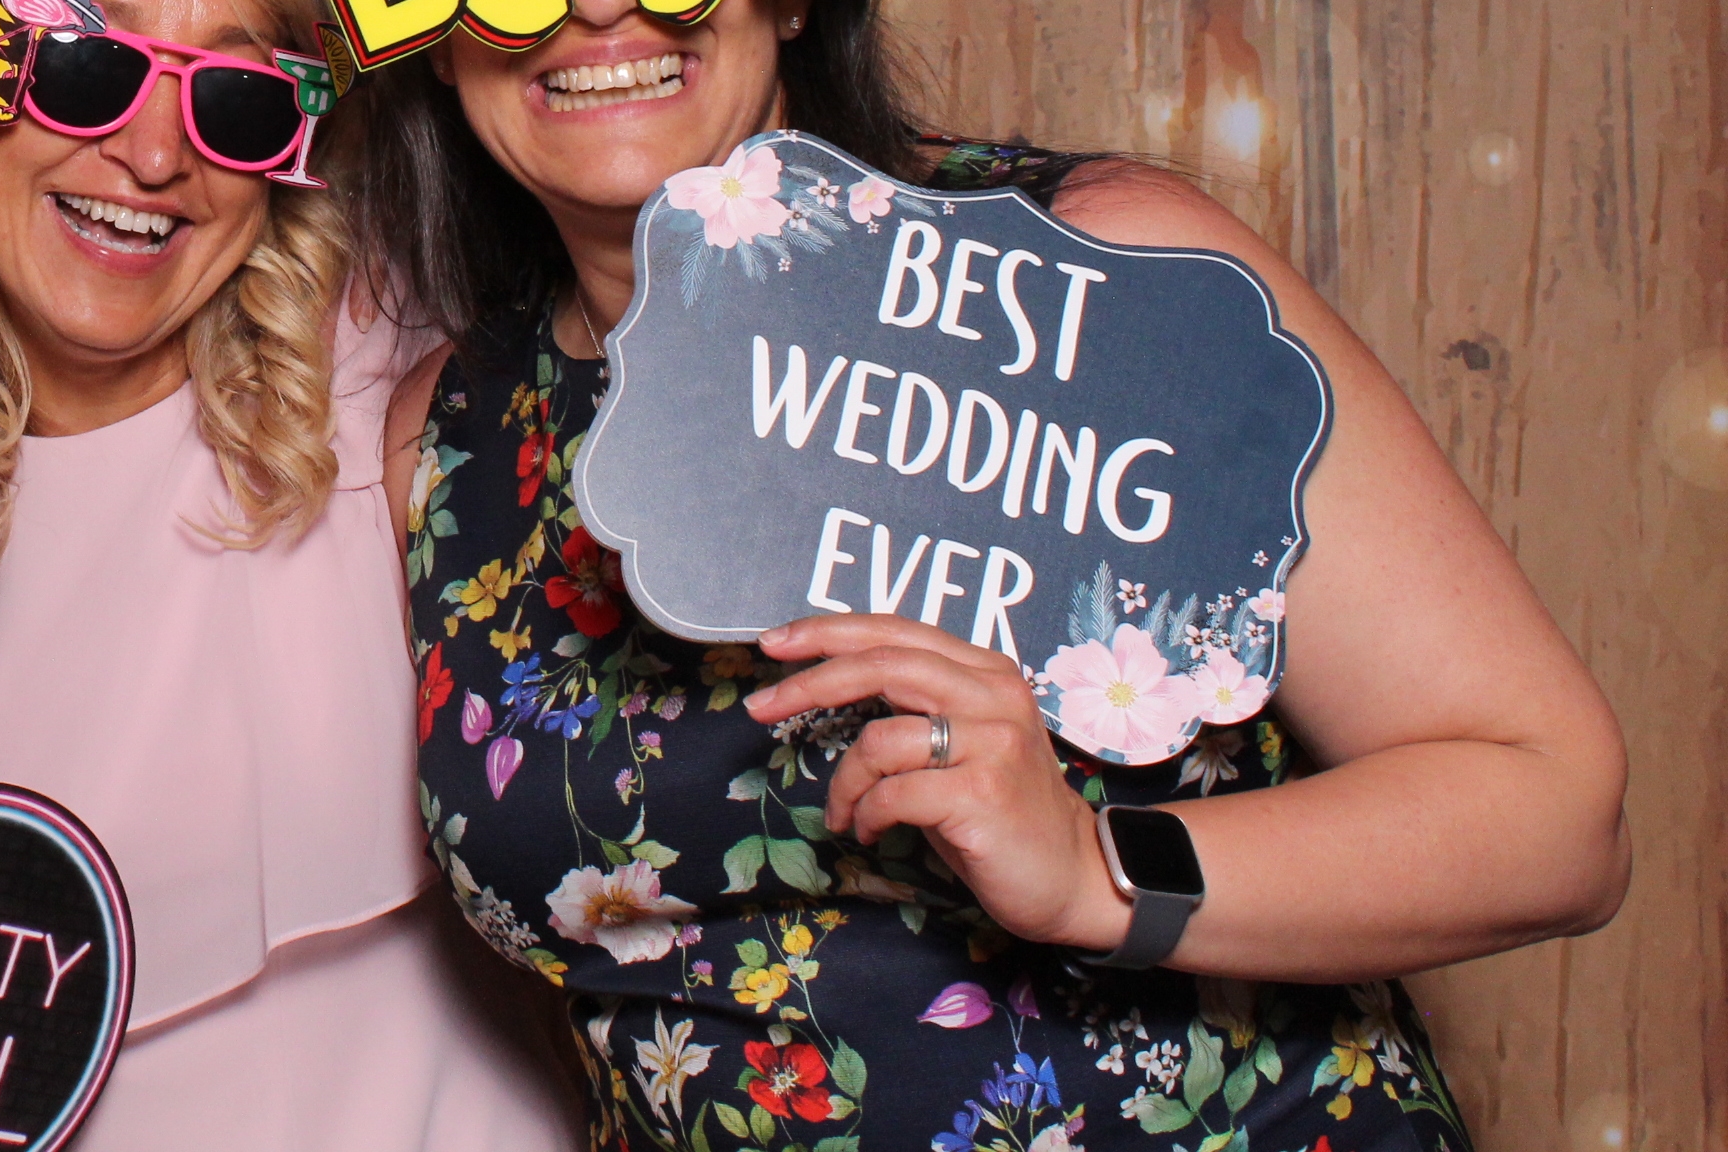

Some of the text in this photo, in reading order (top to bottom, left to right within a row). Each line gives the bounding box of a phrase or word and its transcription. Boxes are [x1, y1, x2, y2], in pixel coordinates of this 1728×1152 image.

[877, 220, 1106, 381] BEST
[752, 335, 1175, 544] WEDDING
[807, 507, 1034, 670] EVER
